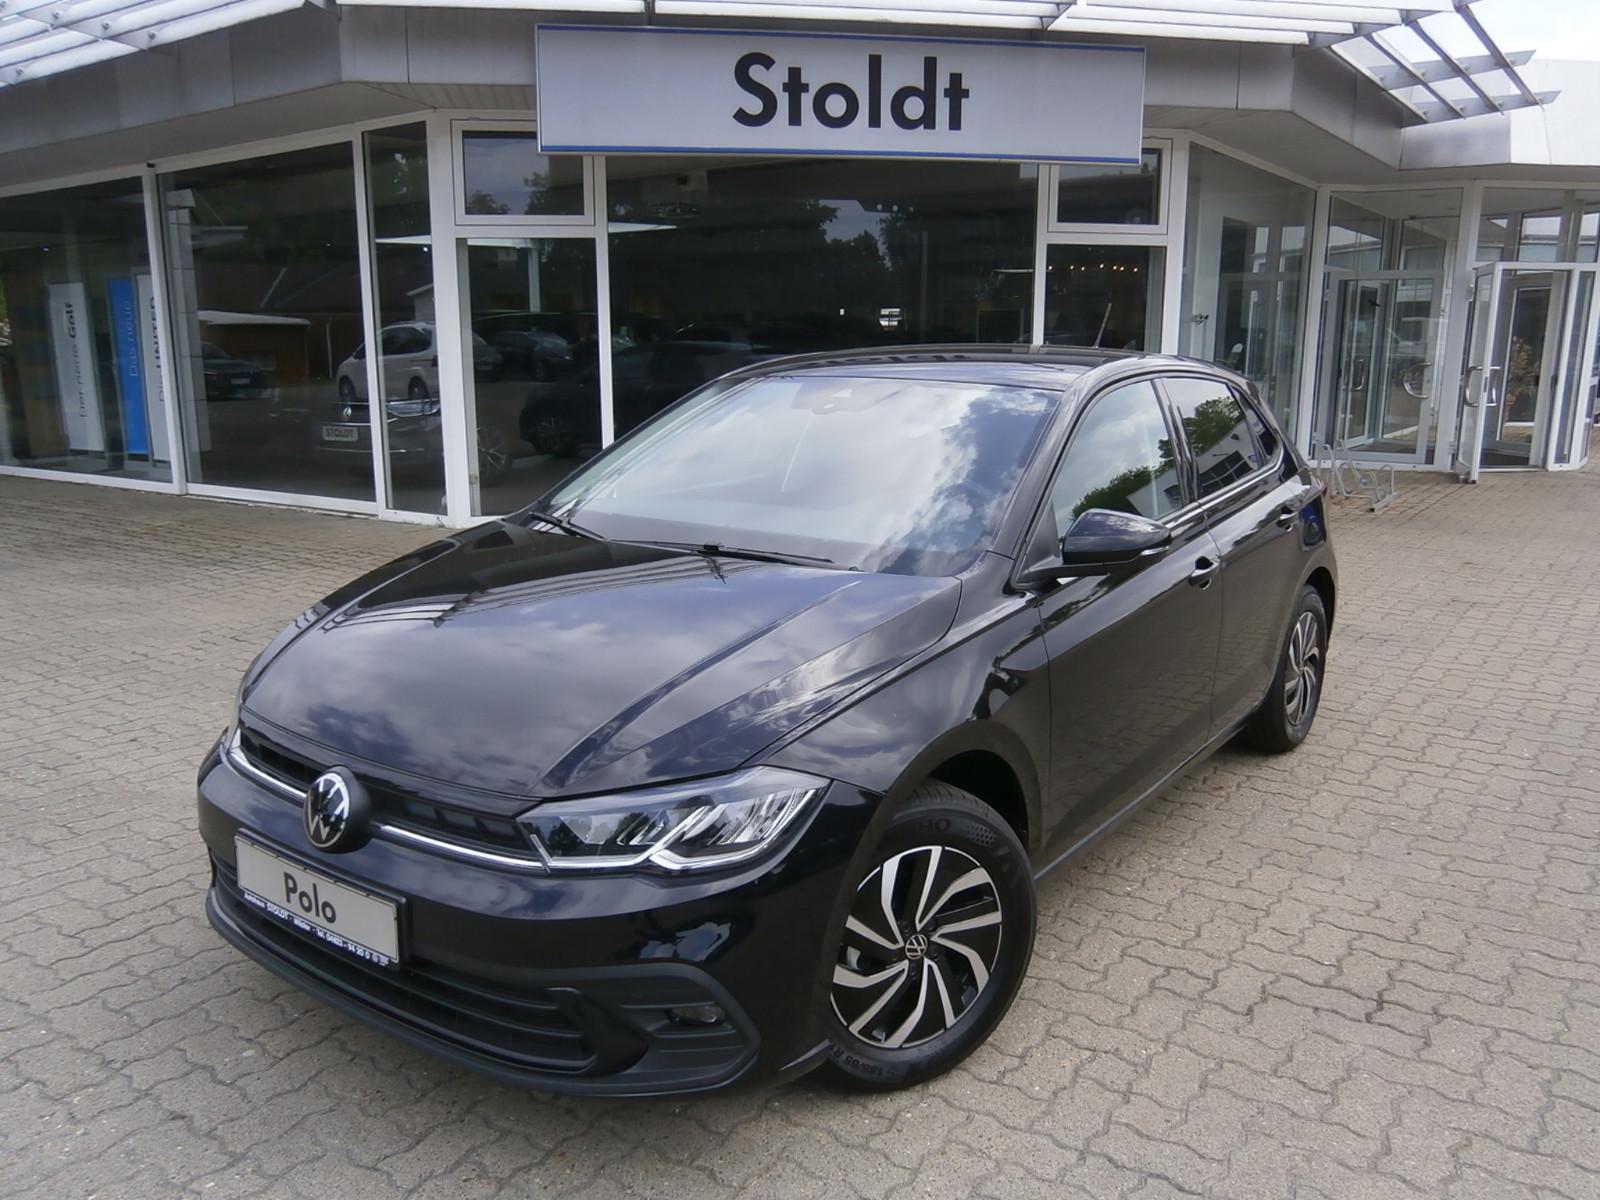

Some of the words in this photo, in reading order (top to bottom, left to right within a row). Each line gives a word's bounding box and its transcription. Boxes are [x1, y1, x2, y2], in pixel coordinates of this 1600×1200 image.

[732, 52, 970, 131] Stoldt
[64, 302, 77, 339] Golf
[124, 300, 135, 342] neue
[127, 346, 139, 377] Das
[284, 871, 337, 924] Polo
